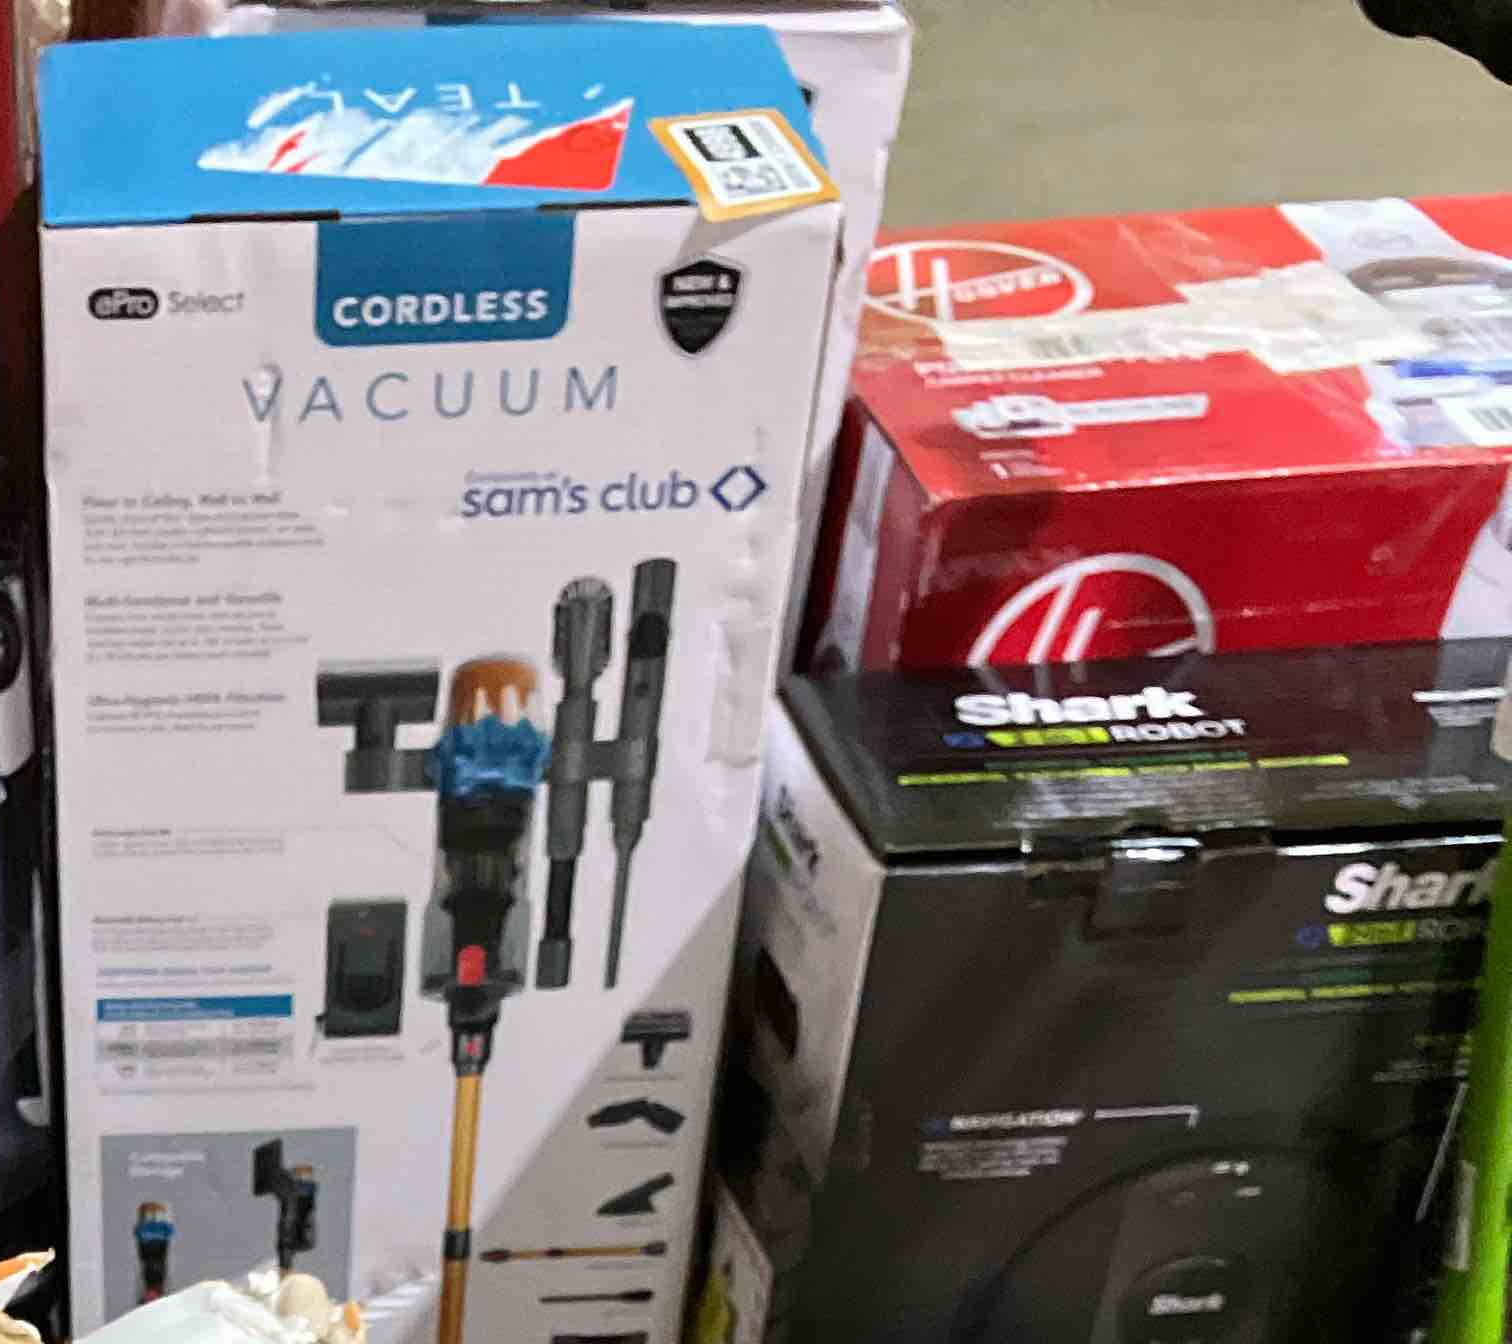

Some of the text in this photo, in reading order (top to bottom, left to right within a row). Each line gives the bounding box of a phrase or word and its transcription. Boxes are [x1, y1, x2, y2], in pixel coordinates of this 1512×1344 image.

[331, 287, 551, 329] CORDLESS
[241, 364, 621, 425] VACUUM
[460, 469, 698, 519] sam's club
[954, 685, 1205, 727] Shark
